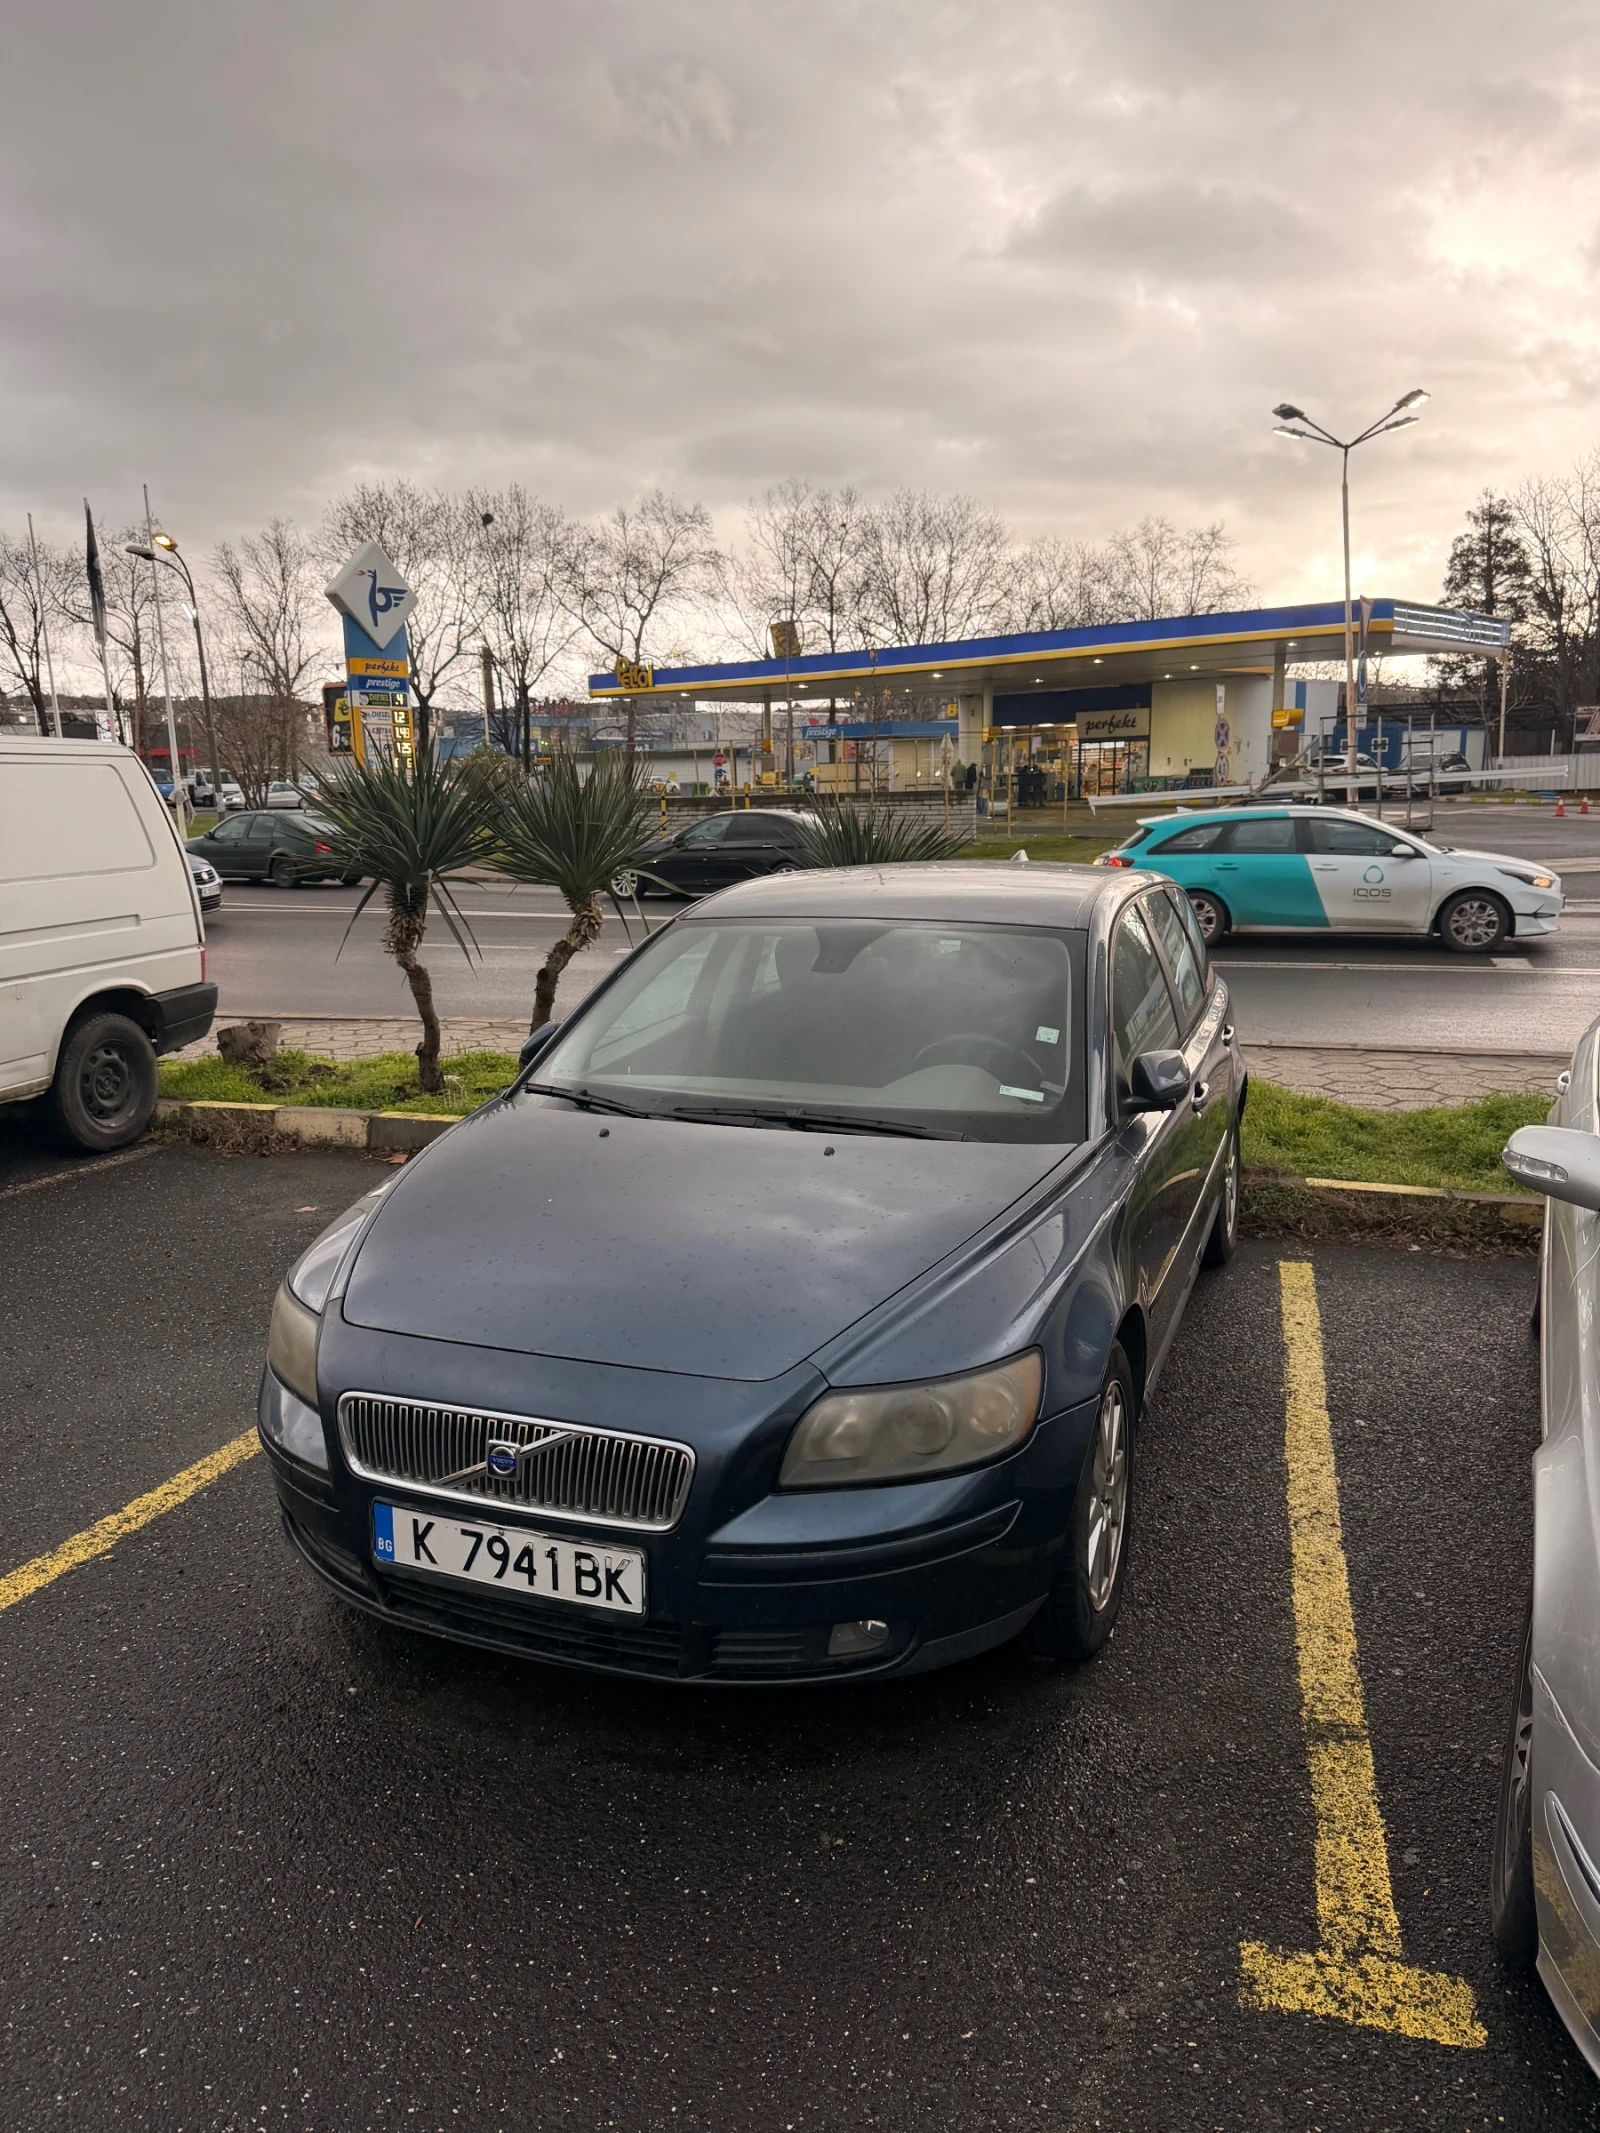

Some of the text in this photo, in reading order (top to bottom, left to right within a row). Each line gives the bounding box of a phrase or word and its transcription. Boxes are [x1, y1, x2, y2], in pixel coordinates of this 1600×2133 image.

[365, 661, 400, 674] perfekt
[616, 656, 653, 689] Petrol
[365, 678, 401, 689] prestige
[369, 693, 389, 702] DIESEL
[1085, 713, 1137, 736] perfekt
[372, 727, 392, 735] EXTRA
[805, 726, 837, 739] prestige
[1352, 888, 1392, 898] IQOS
[492, 1456, 515, 1466] VOLVO
[378, 1536, 393, 1553] BG
